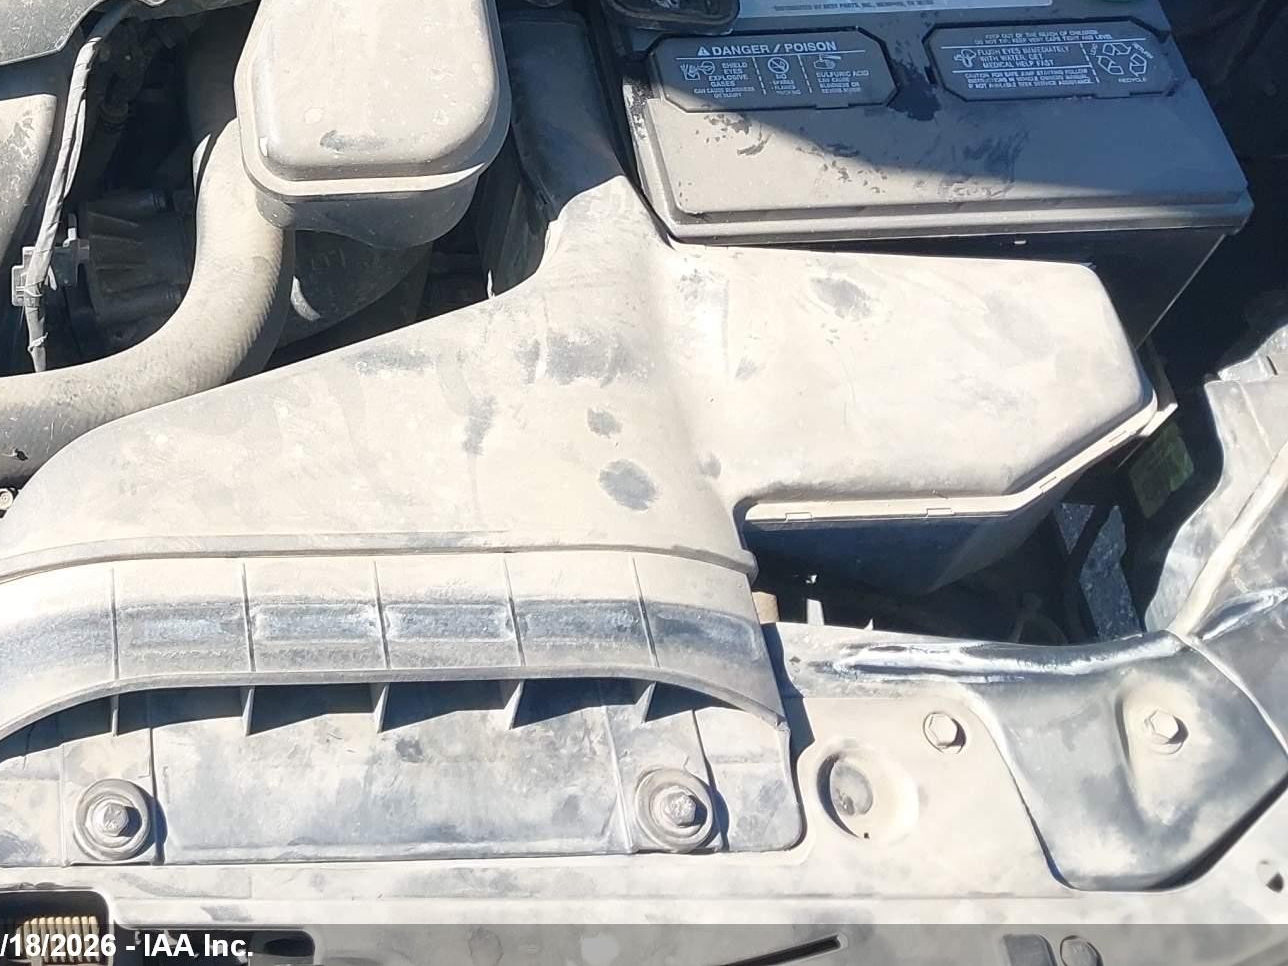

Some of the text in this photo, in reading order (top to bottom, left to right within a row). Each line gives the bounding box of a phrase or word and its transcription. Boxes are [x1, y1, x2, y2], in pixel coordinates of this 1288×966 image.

[712, 41, 837, 56] DANGER / POISON
[980, 55, 1001, 63] WITH
[721, 61, 748, 69] SHIELD
